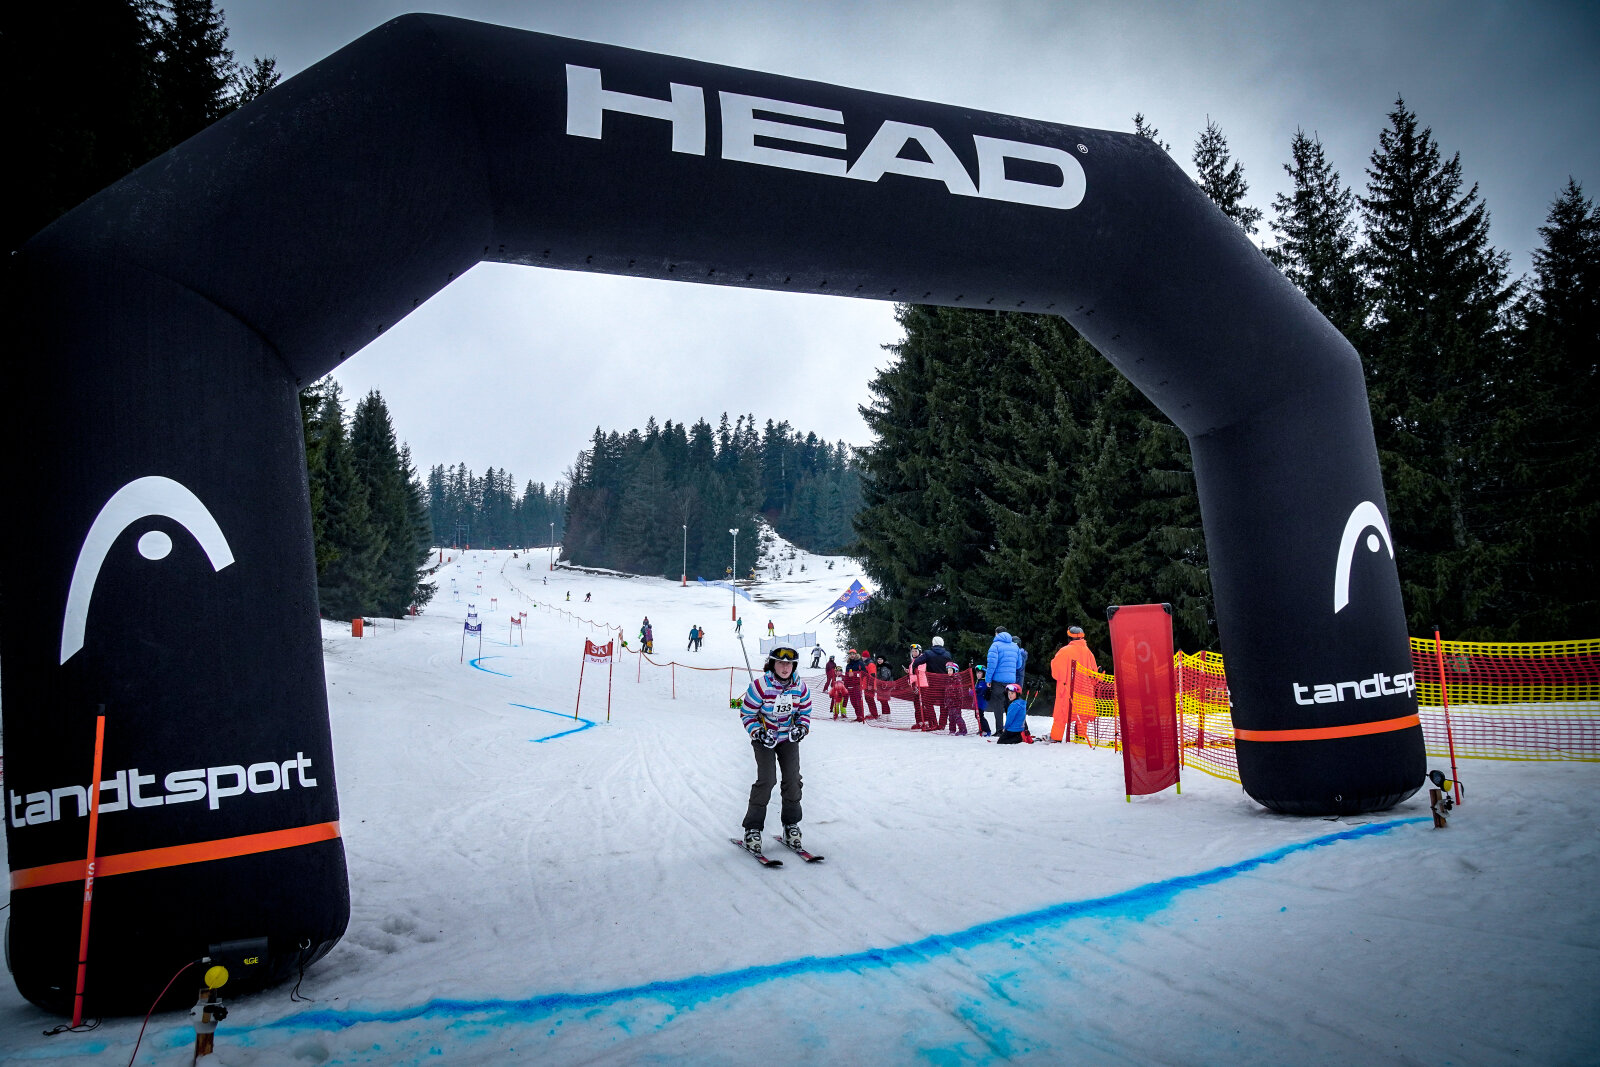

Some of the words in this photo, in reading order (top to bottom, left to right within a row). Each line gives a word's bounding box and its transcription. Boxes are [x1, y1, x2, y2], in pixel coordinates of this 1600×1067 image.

[565, 63, 1087, 210] HEAD
[591, 645, 609, 655] SKI
[1293, 671, 1416, 705] tandtsp
[776, 703, 792, 713] 133
[9, 751, 317, 828] tandtsport
